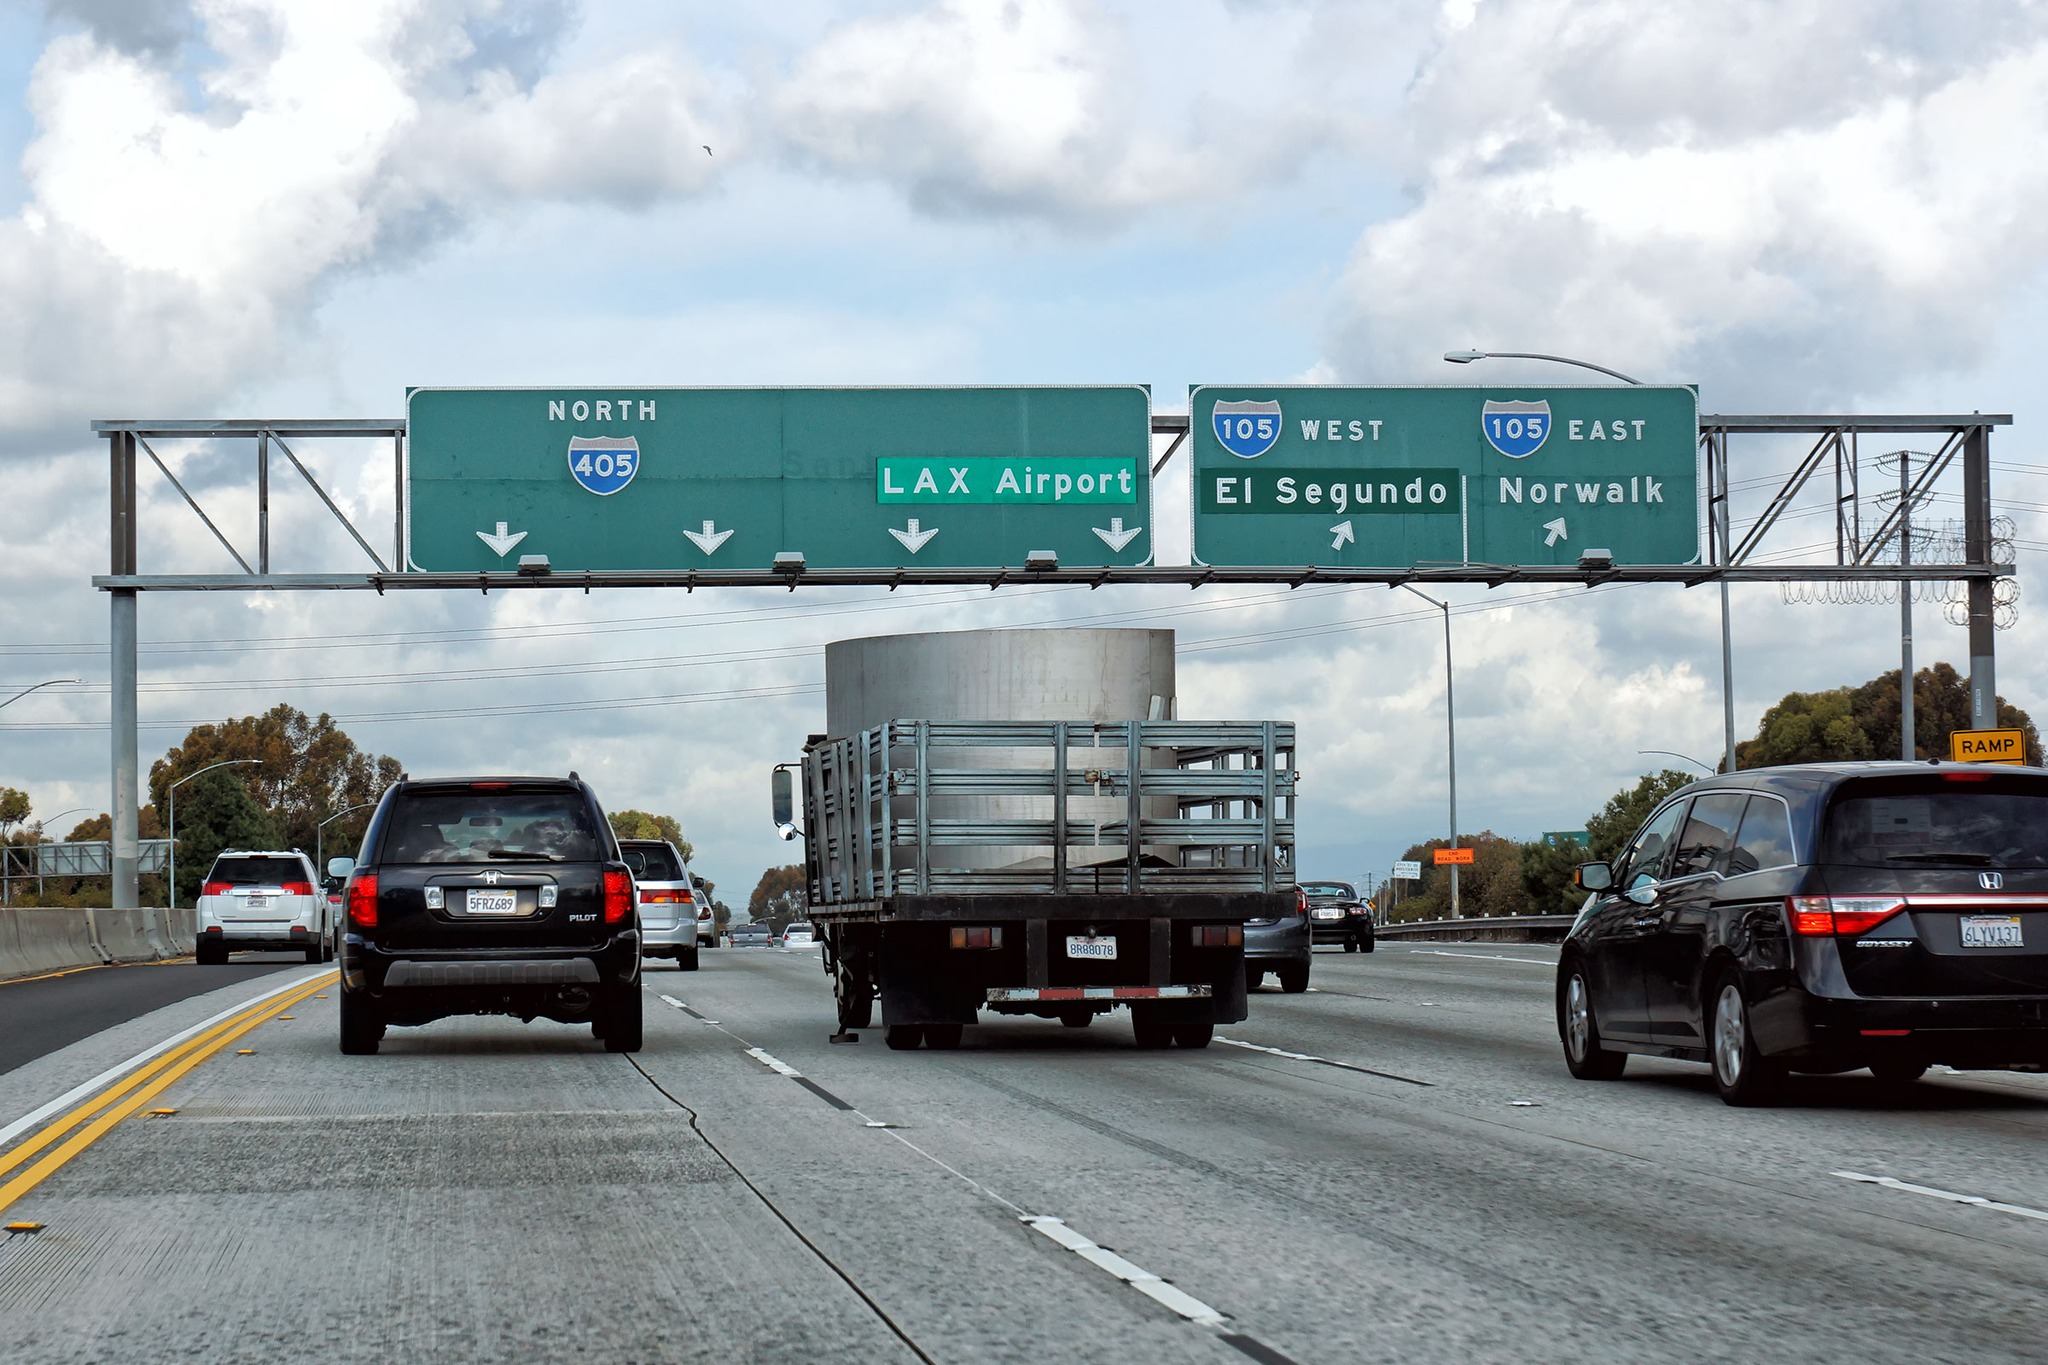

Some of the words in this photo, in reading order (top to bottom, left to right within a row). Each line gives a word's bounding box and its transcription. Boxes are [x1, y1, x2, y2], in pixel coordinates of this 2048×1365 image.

[549, 400, 656, 421] NORTH
[1223, 418, 1273, 440] 105
[1300, 419, 1383, 441] WEST
[1492, 418, 1543, 439] 105
[1568, 419, 1646, 441] EAST
[574, 454, 633, 477] 405
[884, 467, 970, 494] LAX
[995, 466, 1132, 501] Airport
[1499, 476, 1664, 503] Norwalk
[1216, 477, 1252, 504] El
[1276, 476, 1447, 515] Segundo
[1962, 738, 2015, 754] RAMP
[470, 897, 514, 911] 5FRZ689
[569, 914, 598, 922] PILOT
[1855, 940, 1913, 948] ODYSSEY
[1965, 926, 2019, 943] 6LYV137
[1070, 943, 1114, 956] 8R88078
